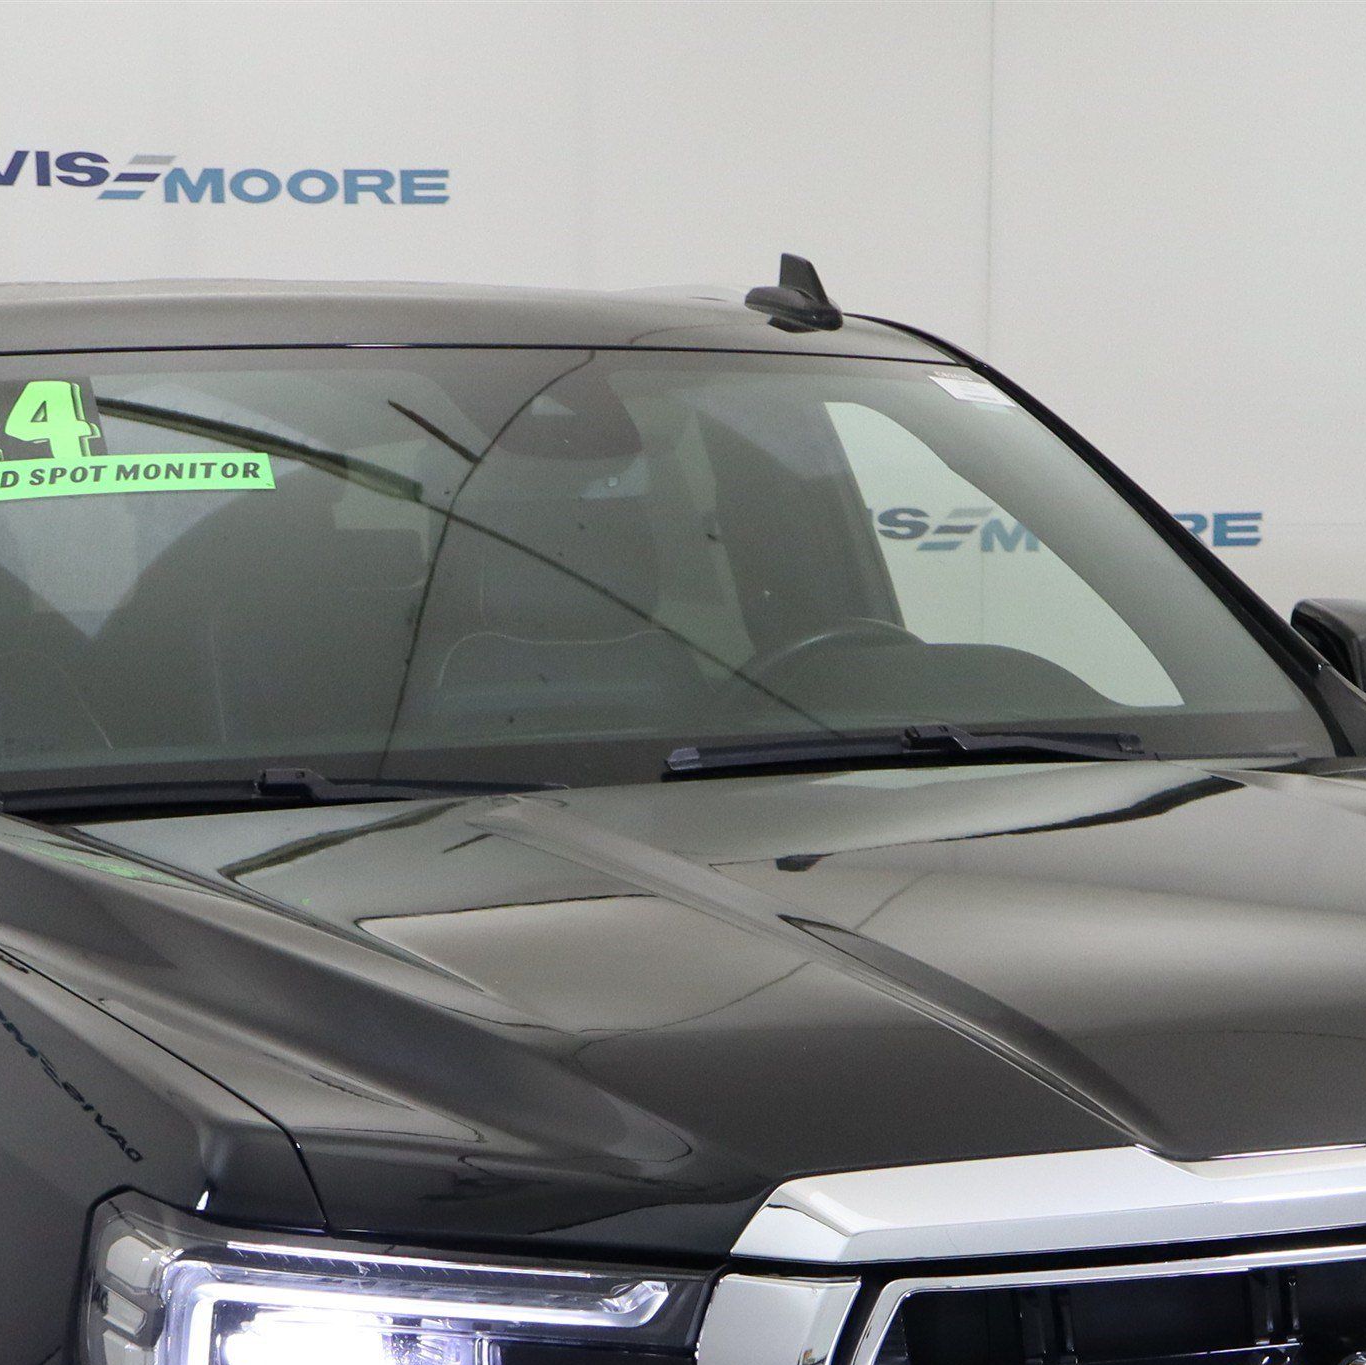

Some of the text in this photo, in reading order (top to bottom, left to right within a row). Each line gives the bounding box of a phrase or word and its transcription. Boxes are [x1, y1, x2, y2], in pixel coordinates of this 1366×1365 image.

[161, 166, 450, 205] MOORE
[29, 465, 107, 486] SPOT
[115, 461, 261, 482] MONITOR
